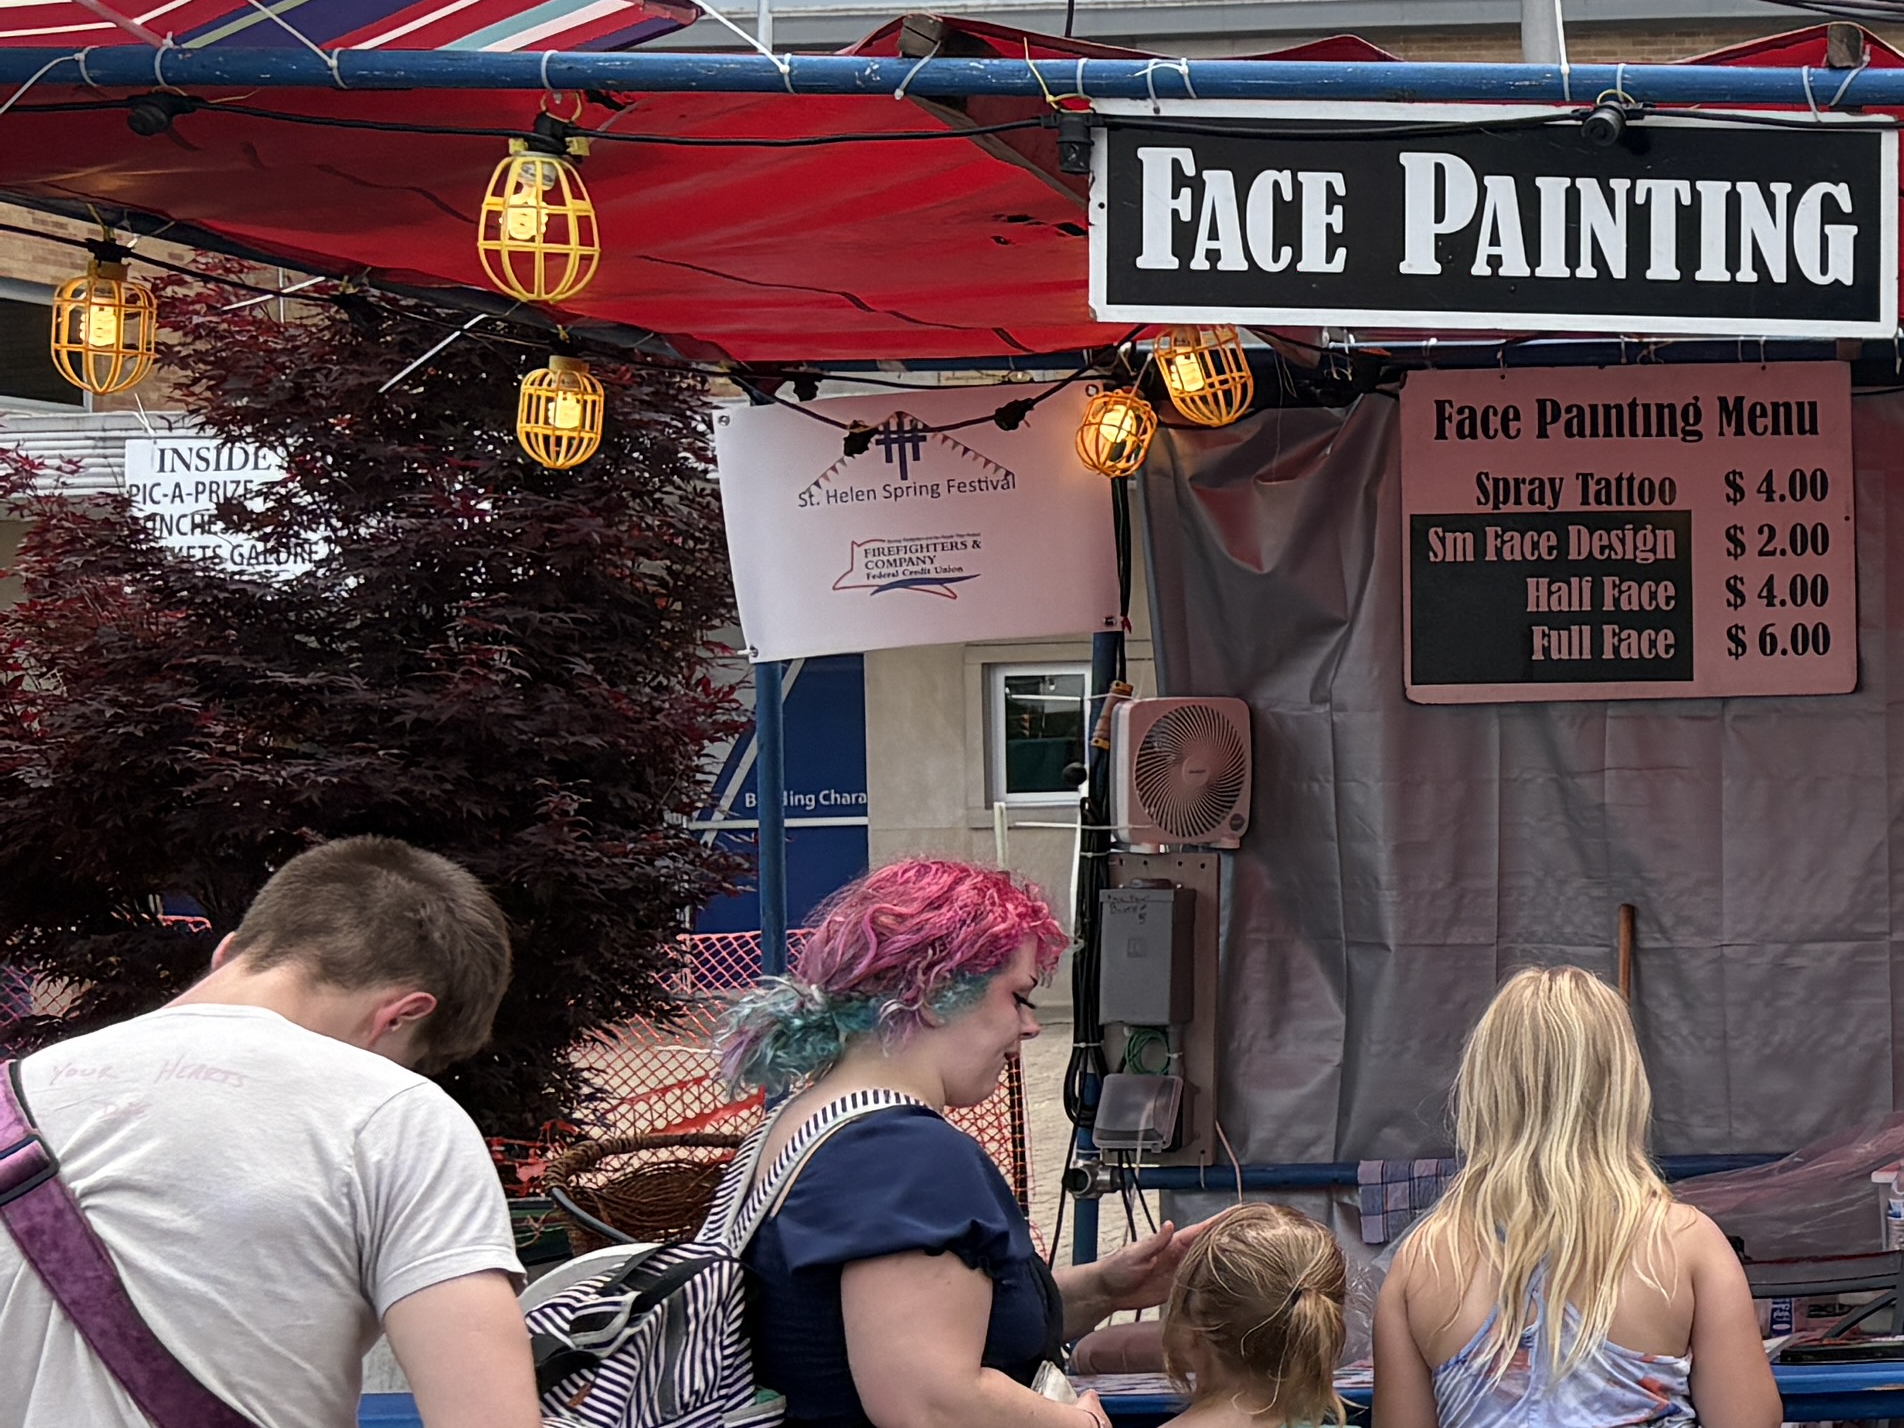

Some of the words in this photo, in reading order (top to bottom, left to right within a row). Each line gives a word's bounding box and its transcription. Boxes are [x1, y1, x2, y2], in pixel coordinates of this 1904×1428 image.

[1136, 147, 1346, 274] FACE
[1400, 152, 1858, 286] PAINTING
[1434, 399, 1521, 440] Face
[1536, 395, 1703, 443] Painting
[1718, 395, 1819, 437] Menu
[157, 446, 272, 473] INSIDE
[798, 493, 820, 508] St.
[826, 487, 877, 505] Helen
[882, 482, 941, 502] Spring
[947, 474, 1016, 494] Festival
[1476, 471, 1564, 510] Spray
[1575, 472, 1677, 506] Tattoo
[1725, 469, 1745, 504] $
[1756, 468, 1829, 502] 4.00
[864, 540, 967, 559] FIREFIGHTERS
[972, 539, 982, 549] &
[1428, 527, 1474, 562] Sm
[1485, 527, 1558, 561] Face
[1567, 524, 1676, 564] Design
[1725, 524, 1746, 560] $
[1756, 522, 1830, 557] 2.00
[865, 555, 937, 571] COMPANY
[866, 570, 899, 580] Federal
[902, 568, 931, 577] Credit
[935, 565, 964, 574] Union
[1526, 577, 1592, 612] Half
[1602, 577, 1676, 611] Face
[1725, 575, 1746, 610] $
[1756, 574, 1829, 608] 4.00
[1531, 626, 1592, 661] Full
[1602, 625, 1676, 660] Face
[1726, 623, 1747, 659] $
[1758, 622, 1831, 657] 6.00
